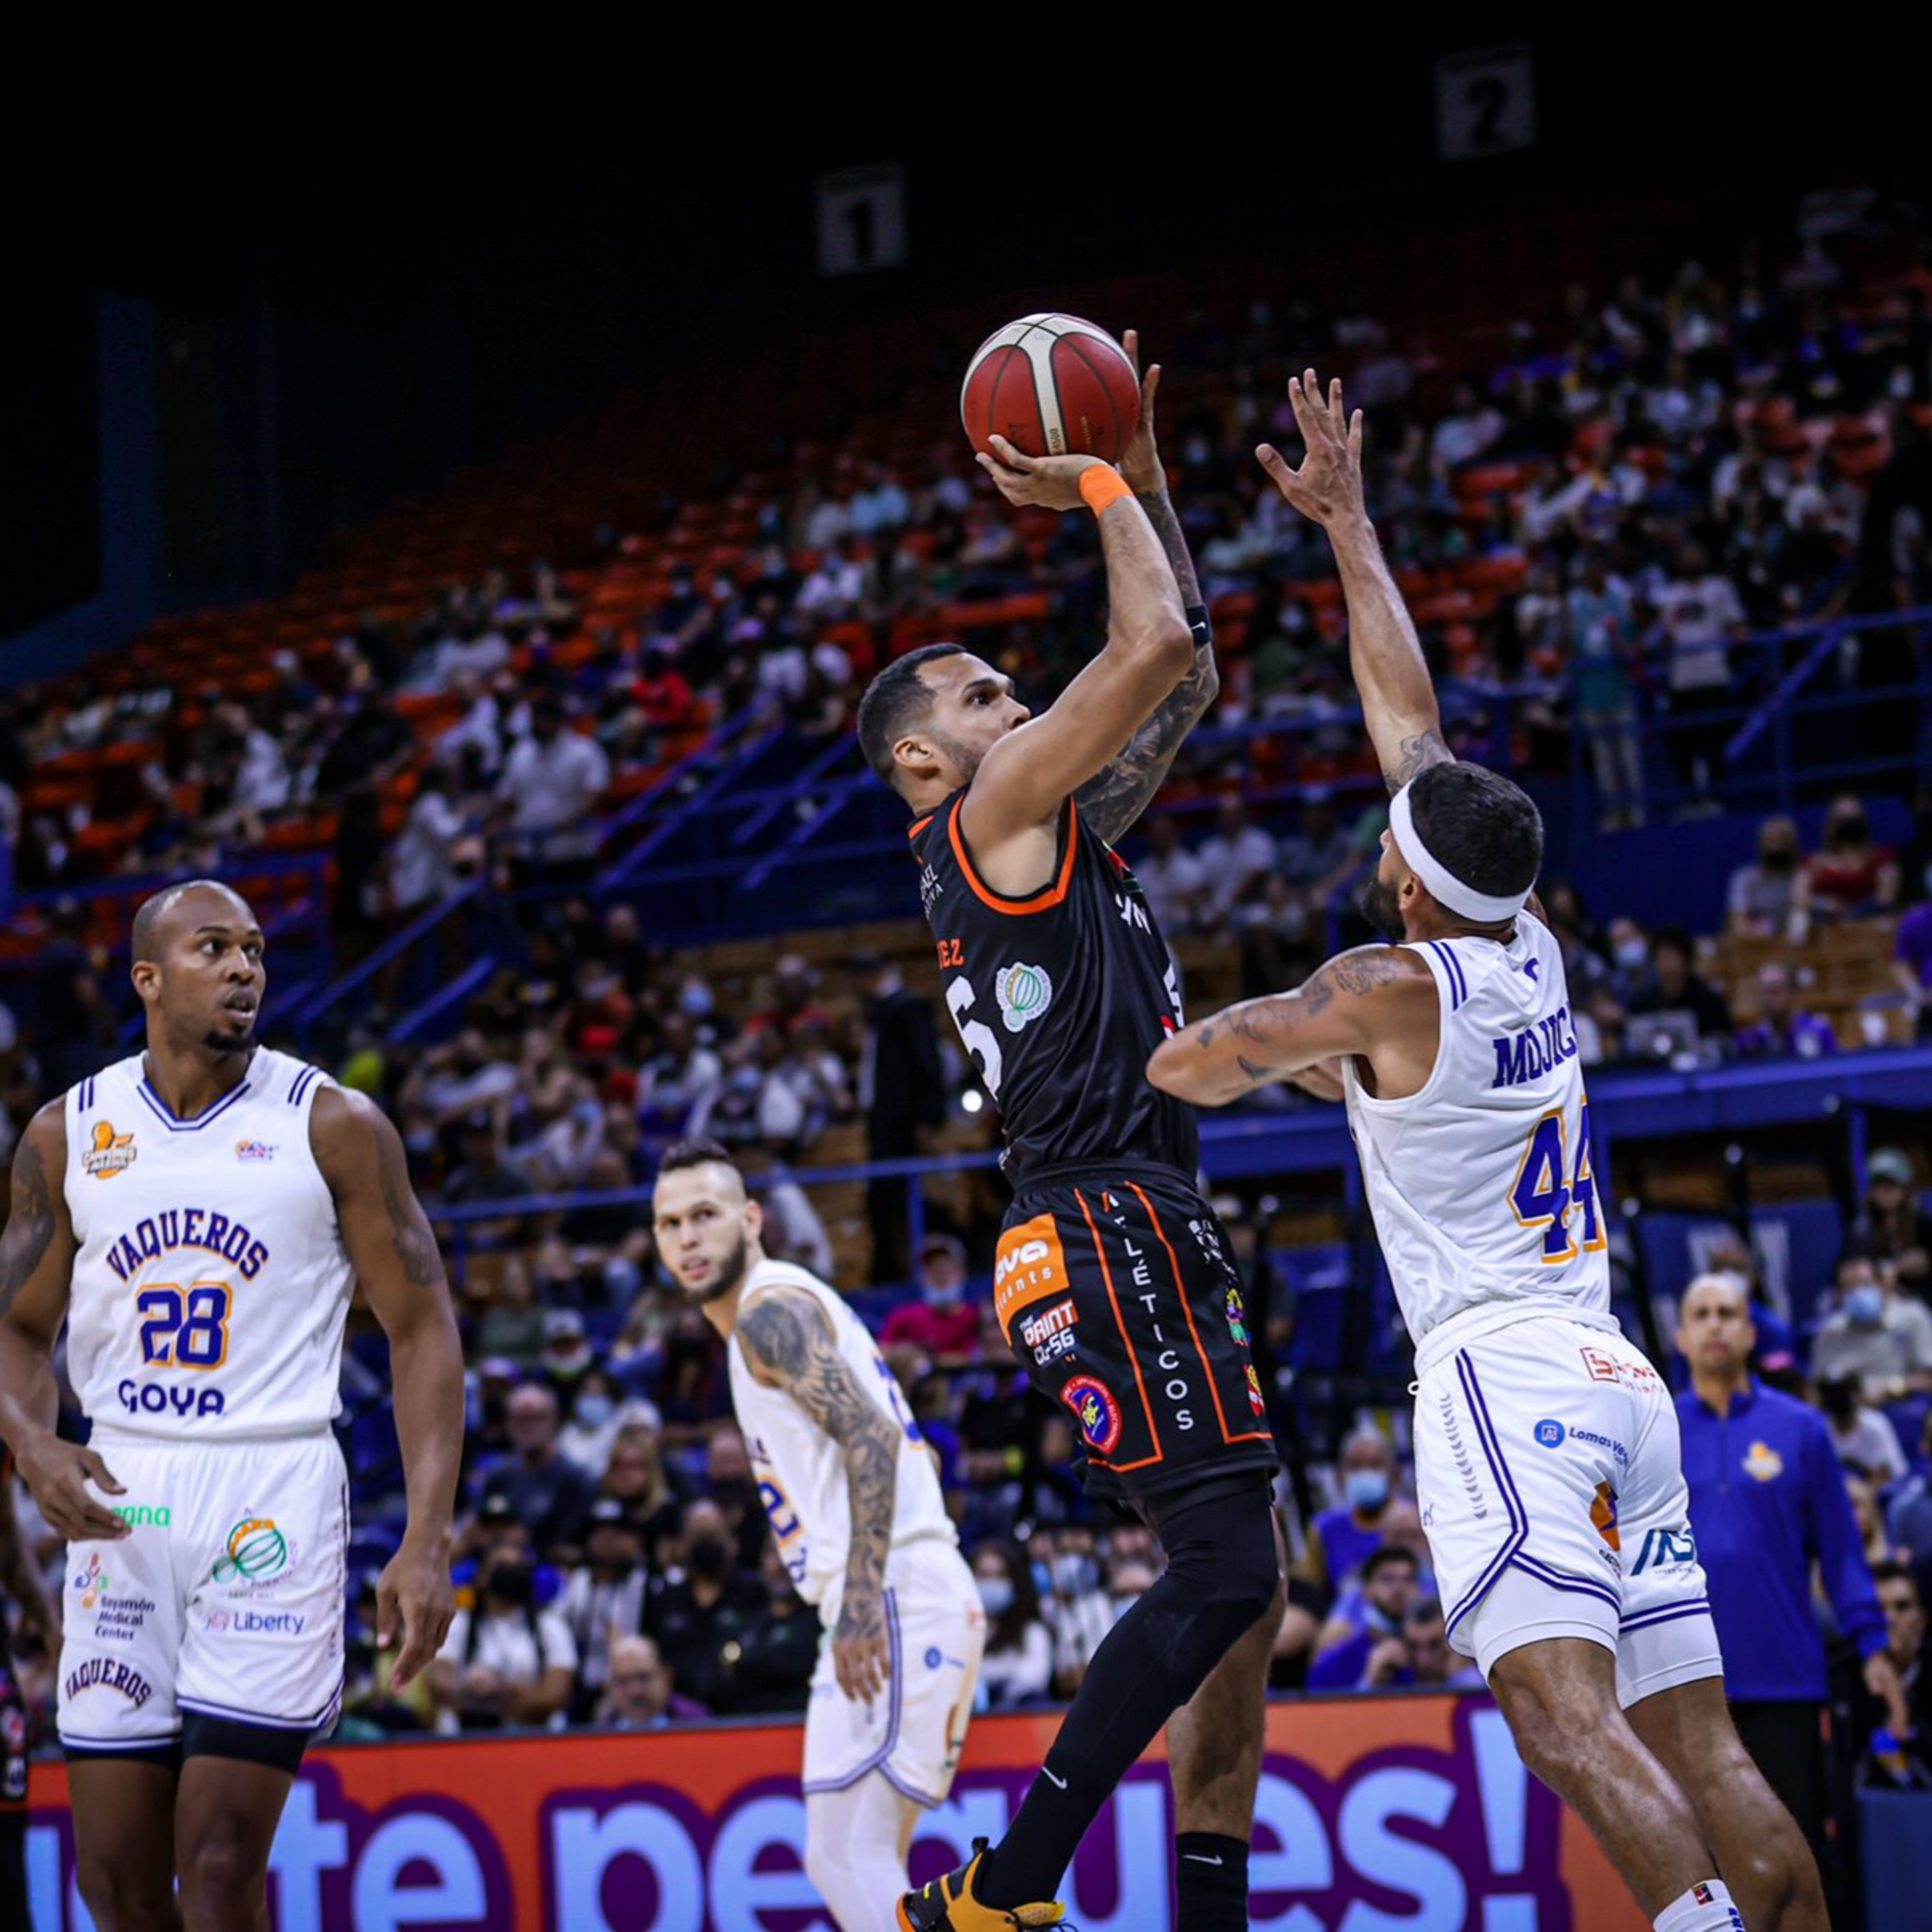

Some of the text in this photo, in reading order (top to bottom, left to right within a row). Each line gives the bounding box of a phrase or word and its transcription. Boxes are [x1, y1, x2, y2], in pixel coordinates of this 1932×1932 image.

[1466, 75, 1511, 149] 2
[936, 938, 964, 971] EZ
[1492, 1000, 1578, 1088] MOJIC
[1506, 1093, 1607, 1264] 44
[106, 1207, 270, 1283] VAQUEROS
[135, 1280, 234, 1372] 28
[1023, 1300, 1074, 1347] PRINT
[118, 1379, 225, 1417] GOYA
[1569, 1421, 1612, 1447] Lomas
[95, 1625, 134, 1641] Center
[99, 1611, 144, 1626] Medical
[234, 1611, 305, 1636] Liberty
